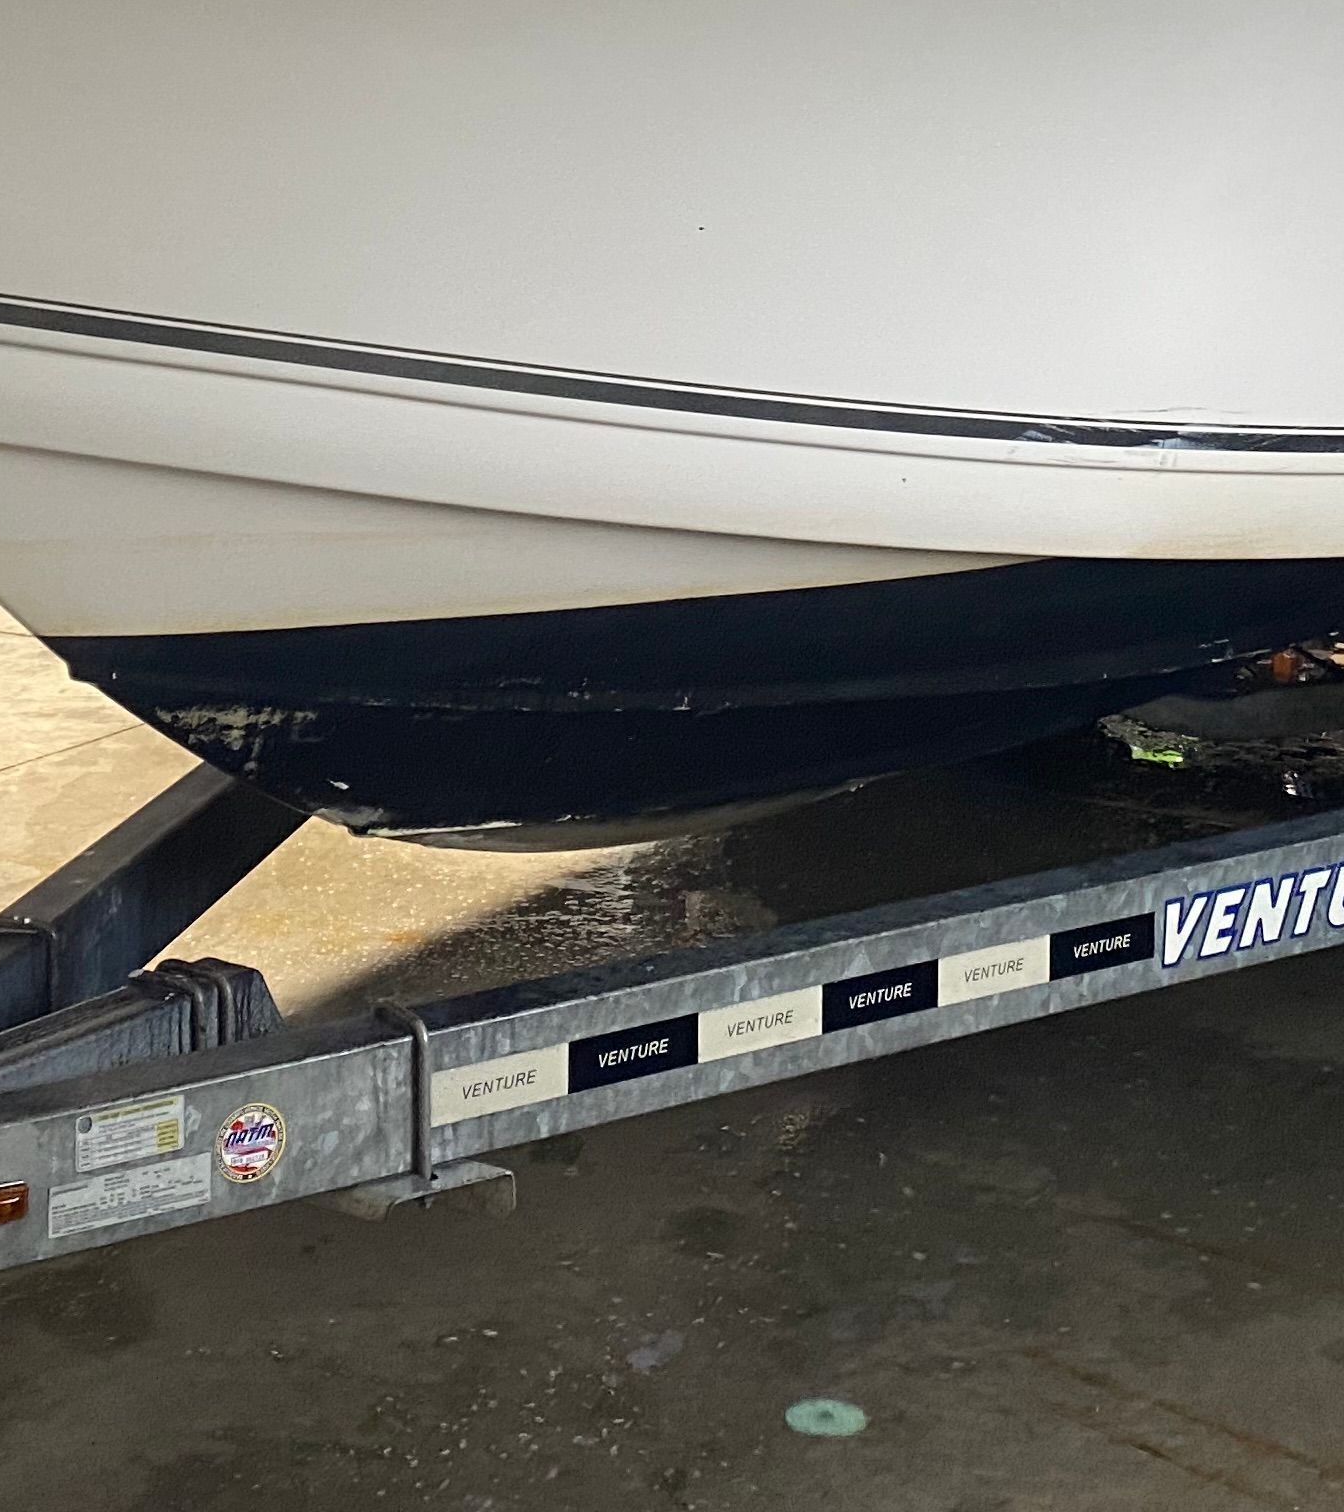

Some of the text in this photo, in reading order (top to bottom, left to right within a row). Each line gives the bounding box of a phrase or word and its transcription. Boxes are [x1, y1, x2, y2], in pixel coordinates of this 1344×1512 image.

[1074, 933, 1132, 959] VENTURE
[964, 958, 1026, 983] VENTURE
[849, 982, 913, 1010] VENTURE
[727, 1009, 795, 1038] VENTURE
[598, 1038, 670, 1068] VENTURE
[462, 1069, 538, 1100] VENTURE
